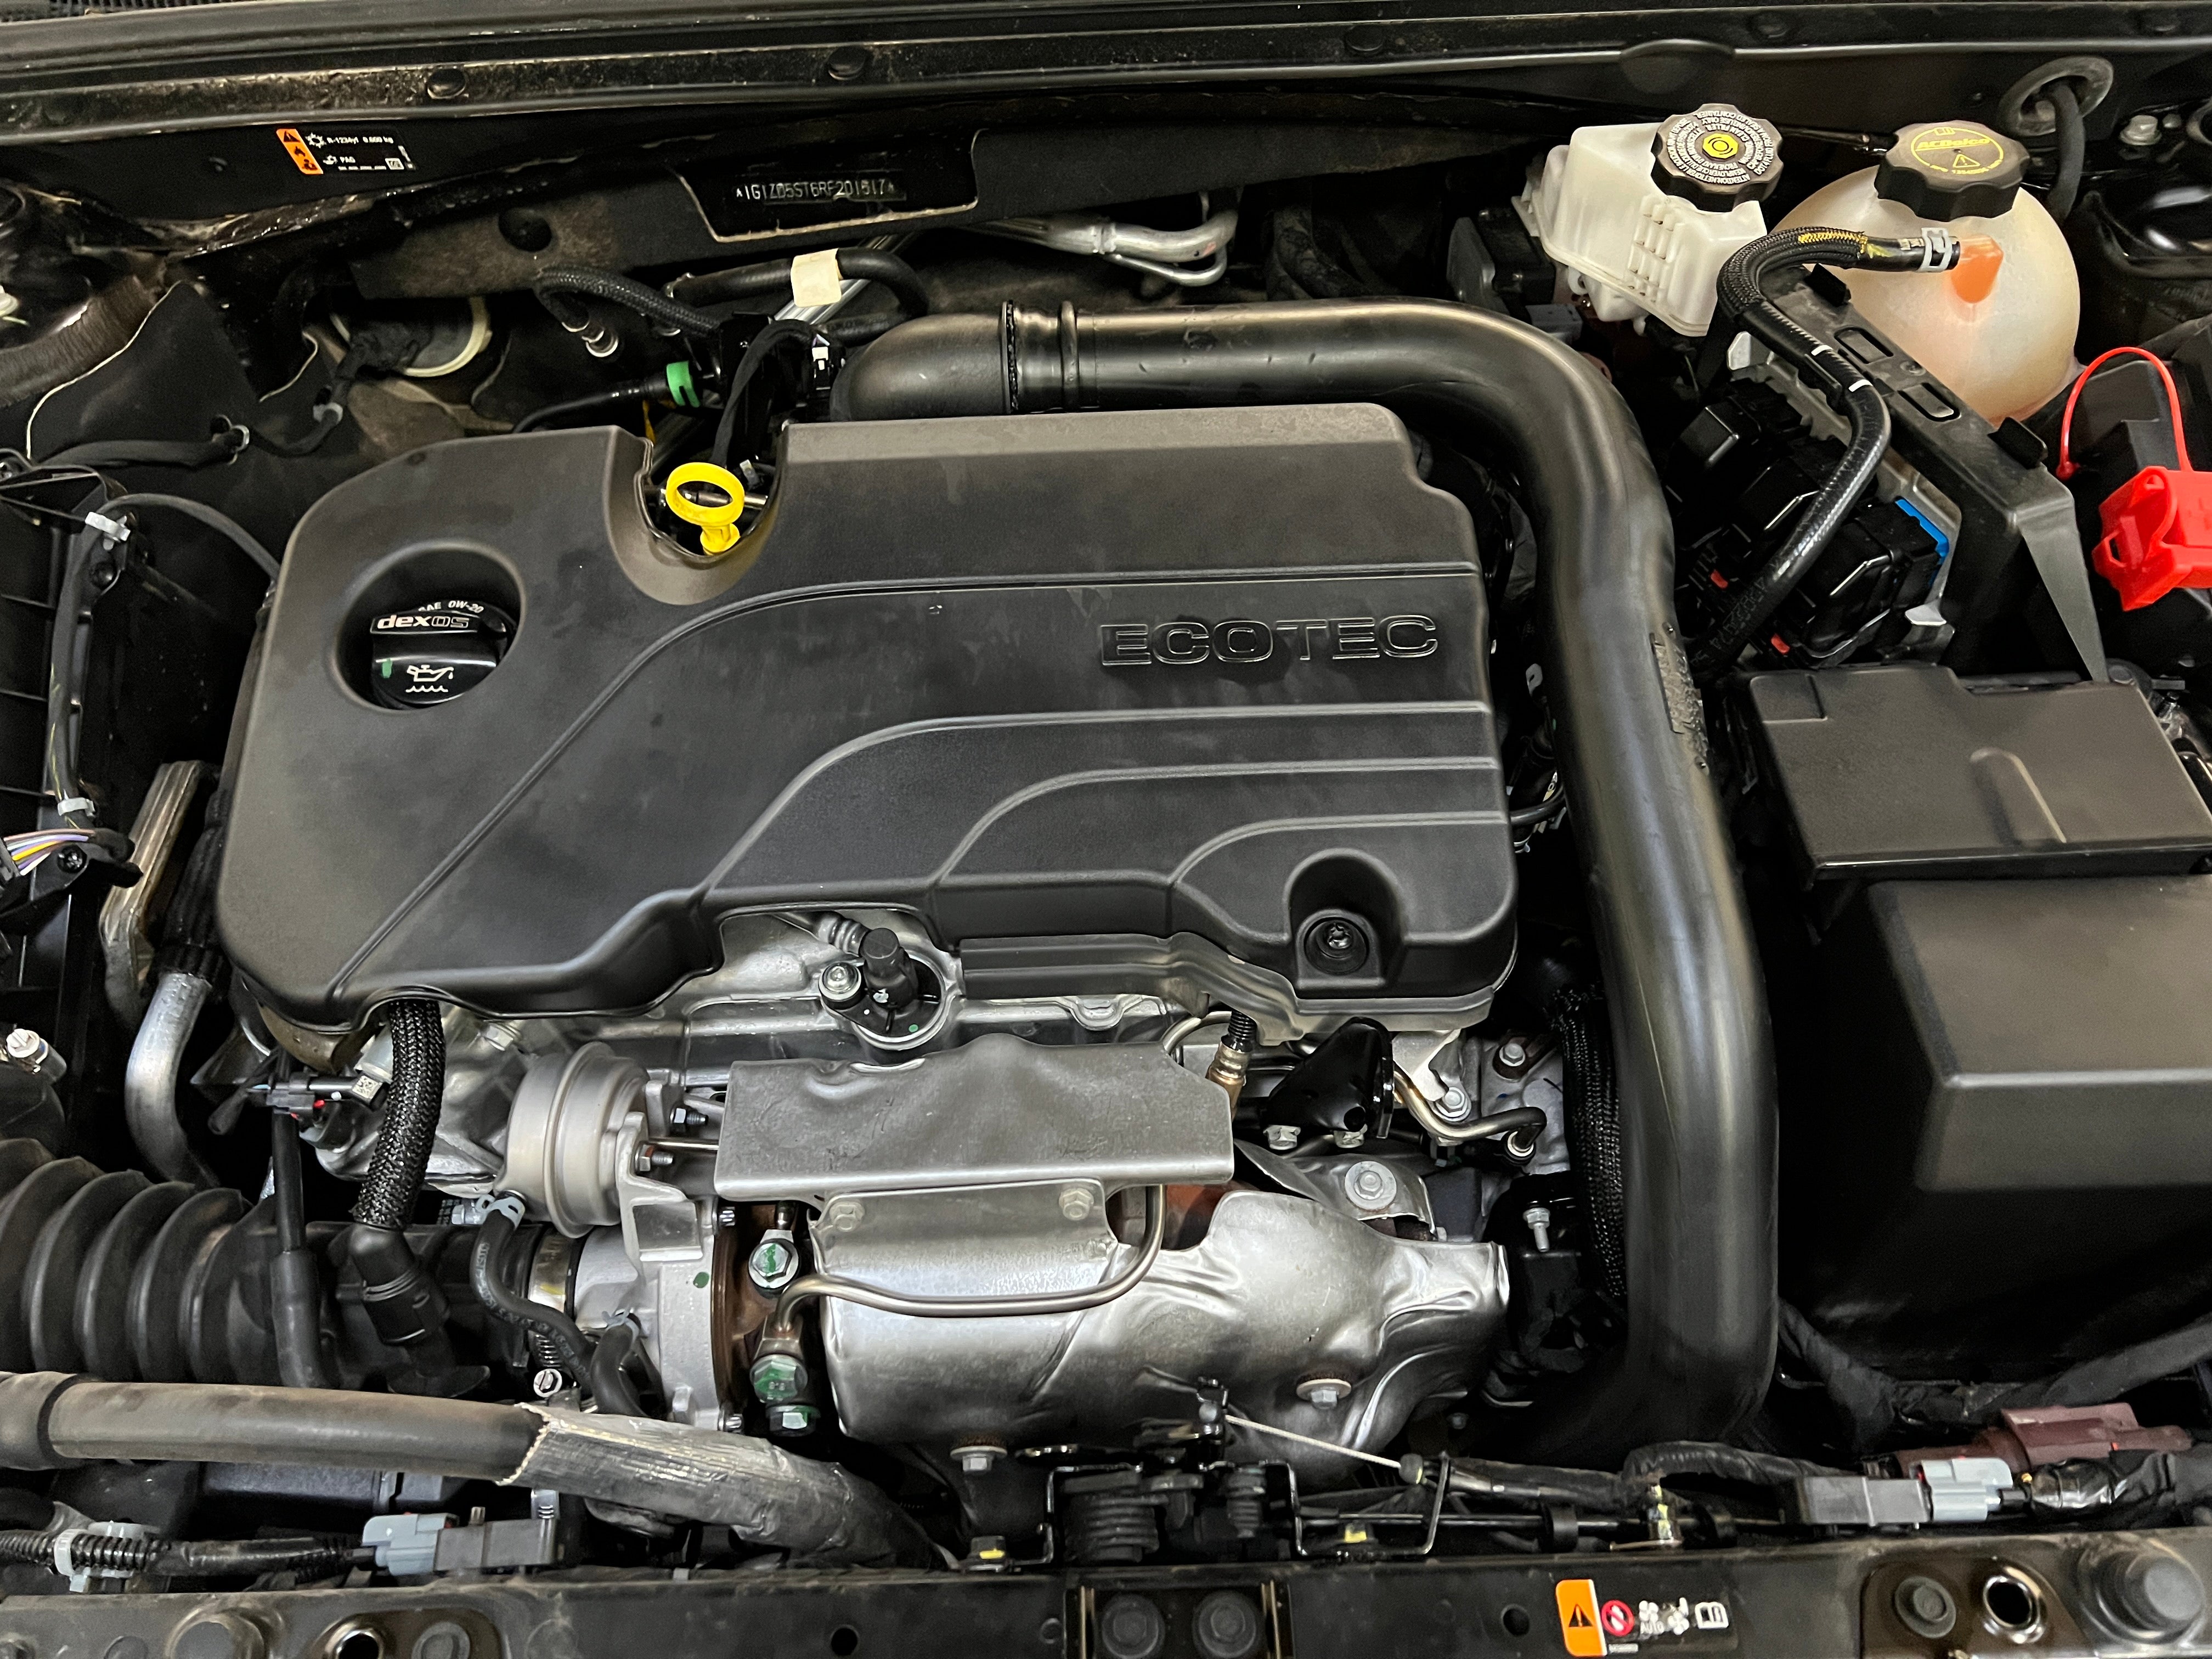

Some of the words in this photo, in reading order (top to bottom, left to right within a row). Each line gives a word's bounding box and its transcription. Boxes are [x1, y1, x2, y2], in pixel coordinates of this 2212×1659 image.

[1736, 115, 1761, 129] SEALED
[1760, 132, 1772, 145] FROM
[448, 600, 484, 613] 0W-20
[1100, 614, 1438, 666] ECOTEC
